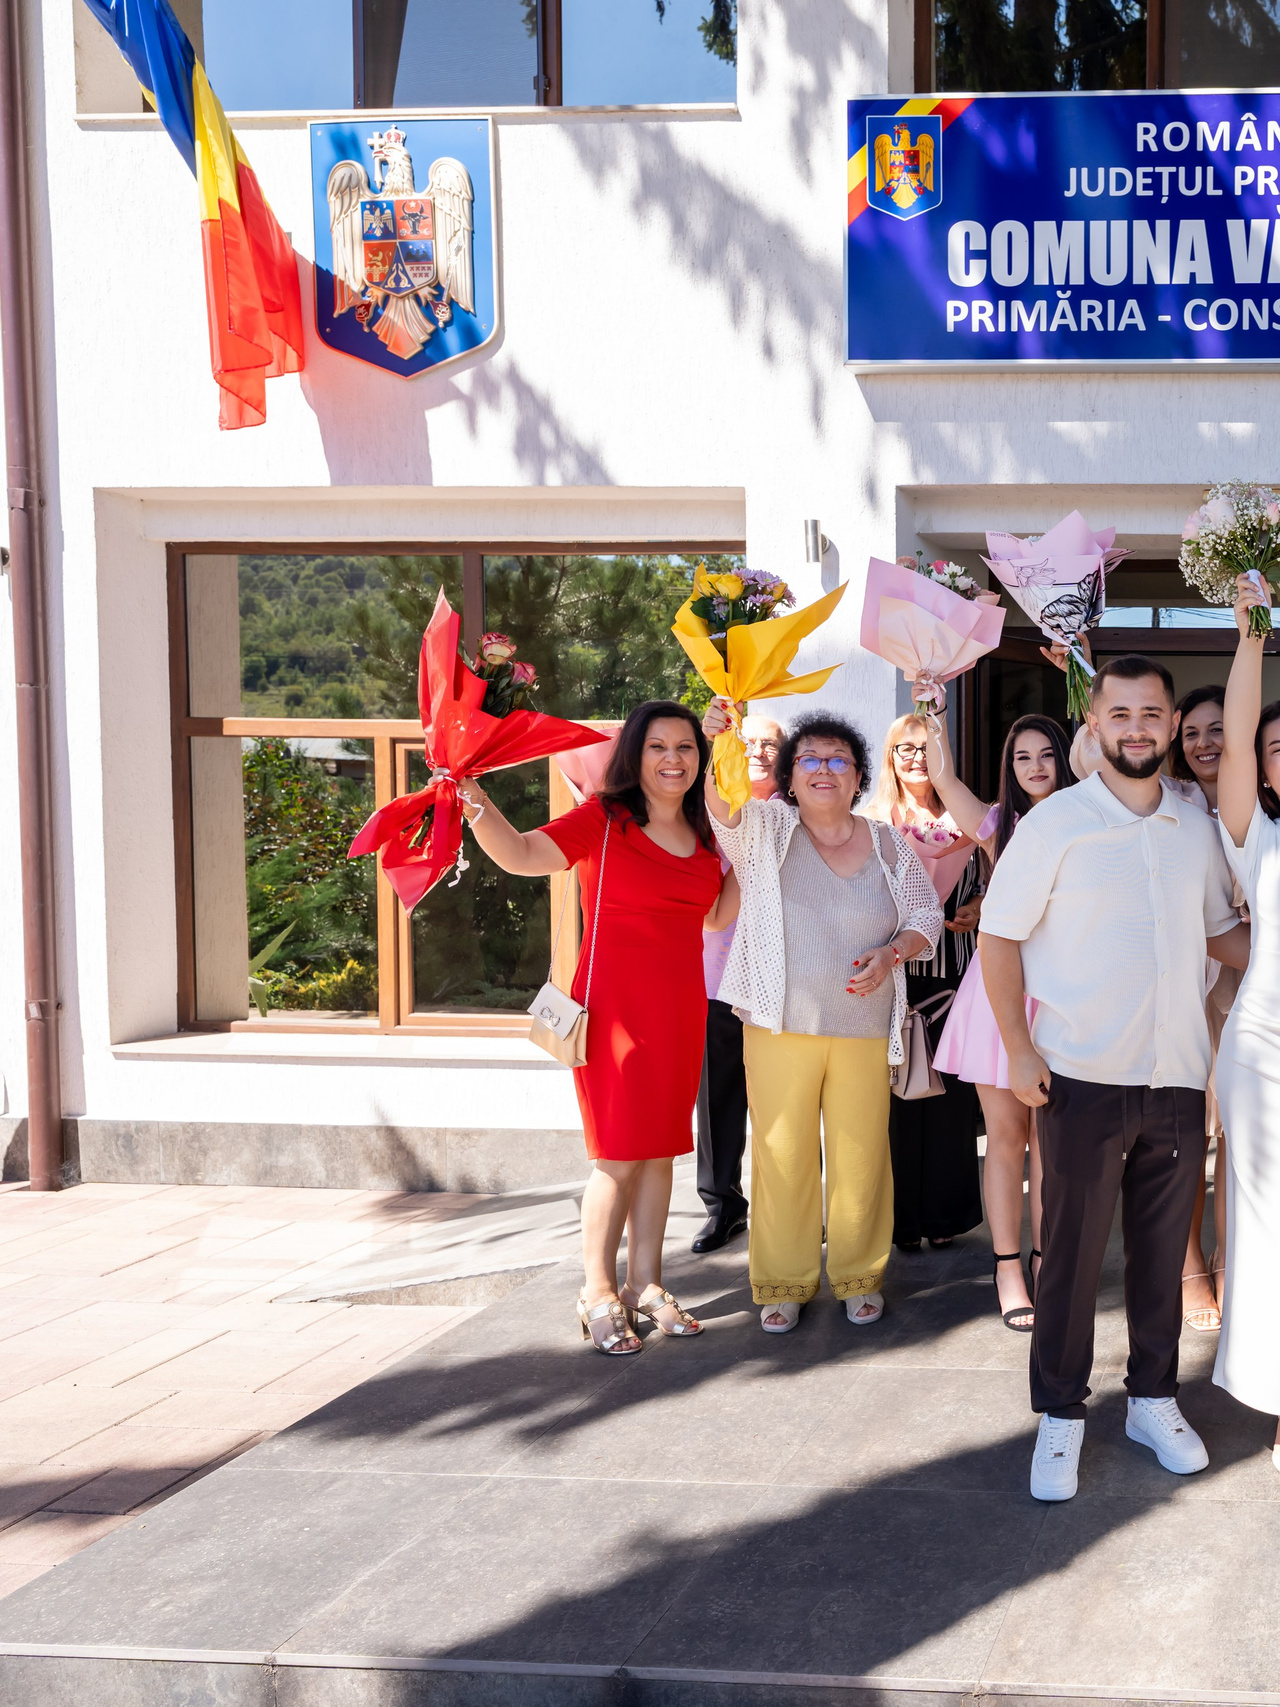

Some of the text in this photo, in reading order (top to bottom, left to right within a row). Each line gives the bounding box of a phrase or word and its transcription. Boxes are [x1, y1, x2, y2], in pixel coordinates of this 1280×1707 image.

[1064, 166, 1223, 204] JUDEȚUL
[947, 219, 1214, 288] COMUNA
[946, 290, 1147, 333] PRIMĂRIA
